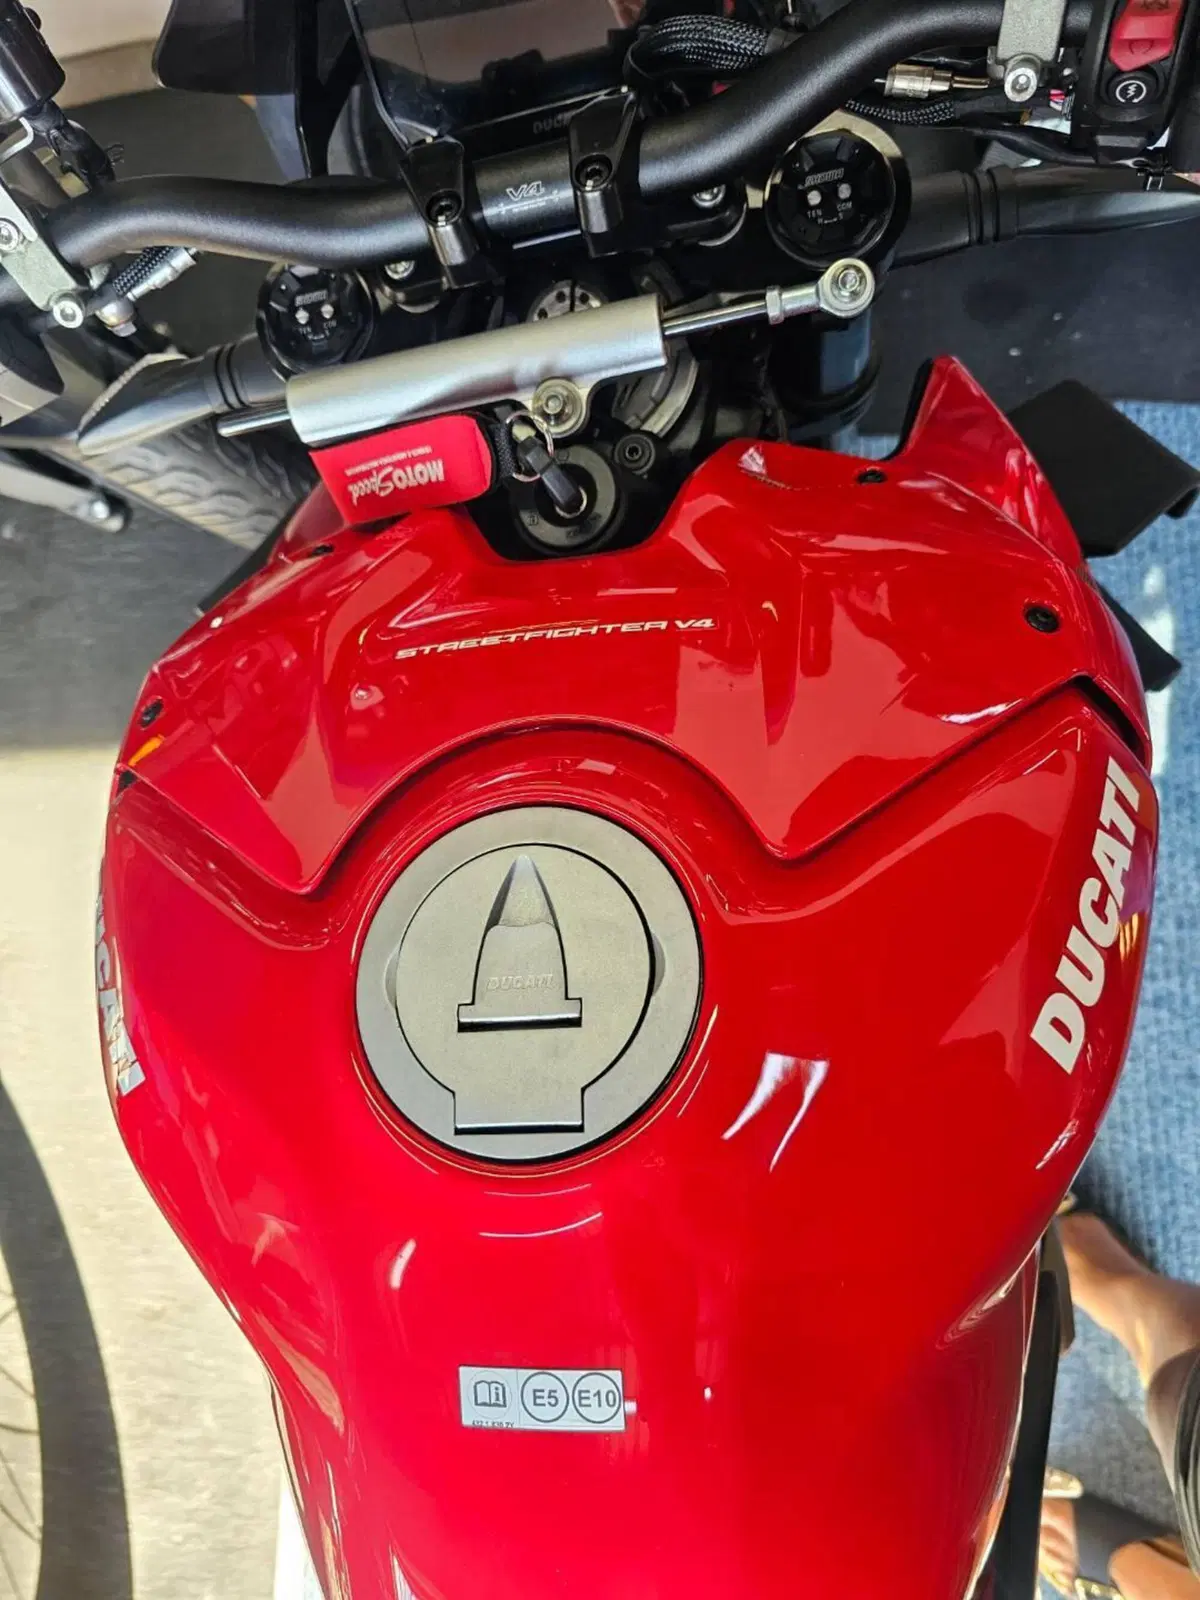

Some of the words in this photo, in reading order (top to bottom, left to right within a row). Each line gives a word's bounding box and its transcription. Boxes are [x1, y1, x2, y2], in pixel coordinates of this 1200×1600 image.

[506, 180, 546, 201] V4
[395, 620, 668, 660] STREETFIGHTER
[674, 618, 715, 629] V4
[1029, 755, 1140, 1075] DUCATI
[486, 973, 554, 991] DUCATI
[532, 1388, 559, 1408] E5
[577, 1390, 617, 1409] E10
